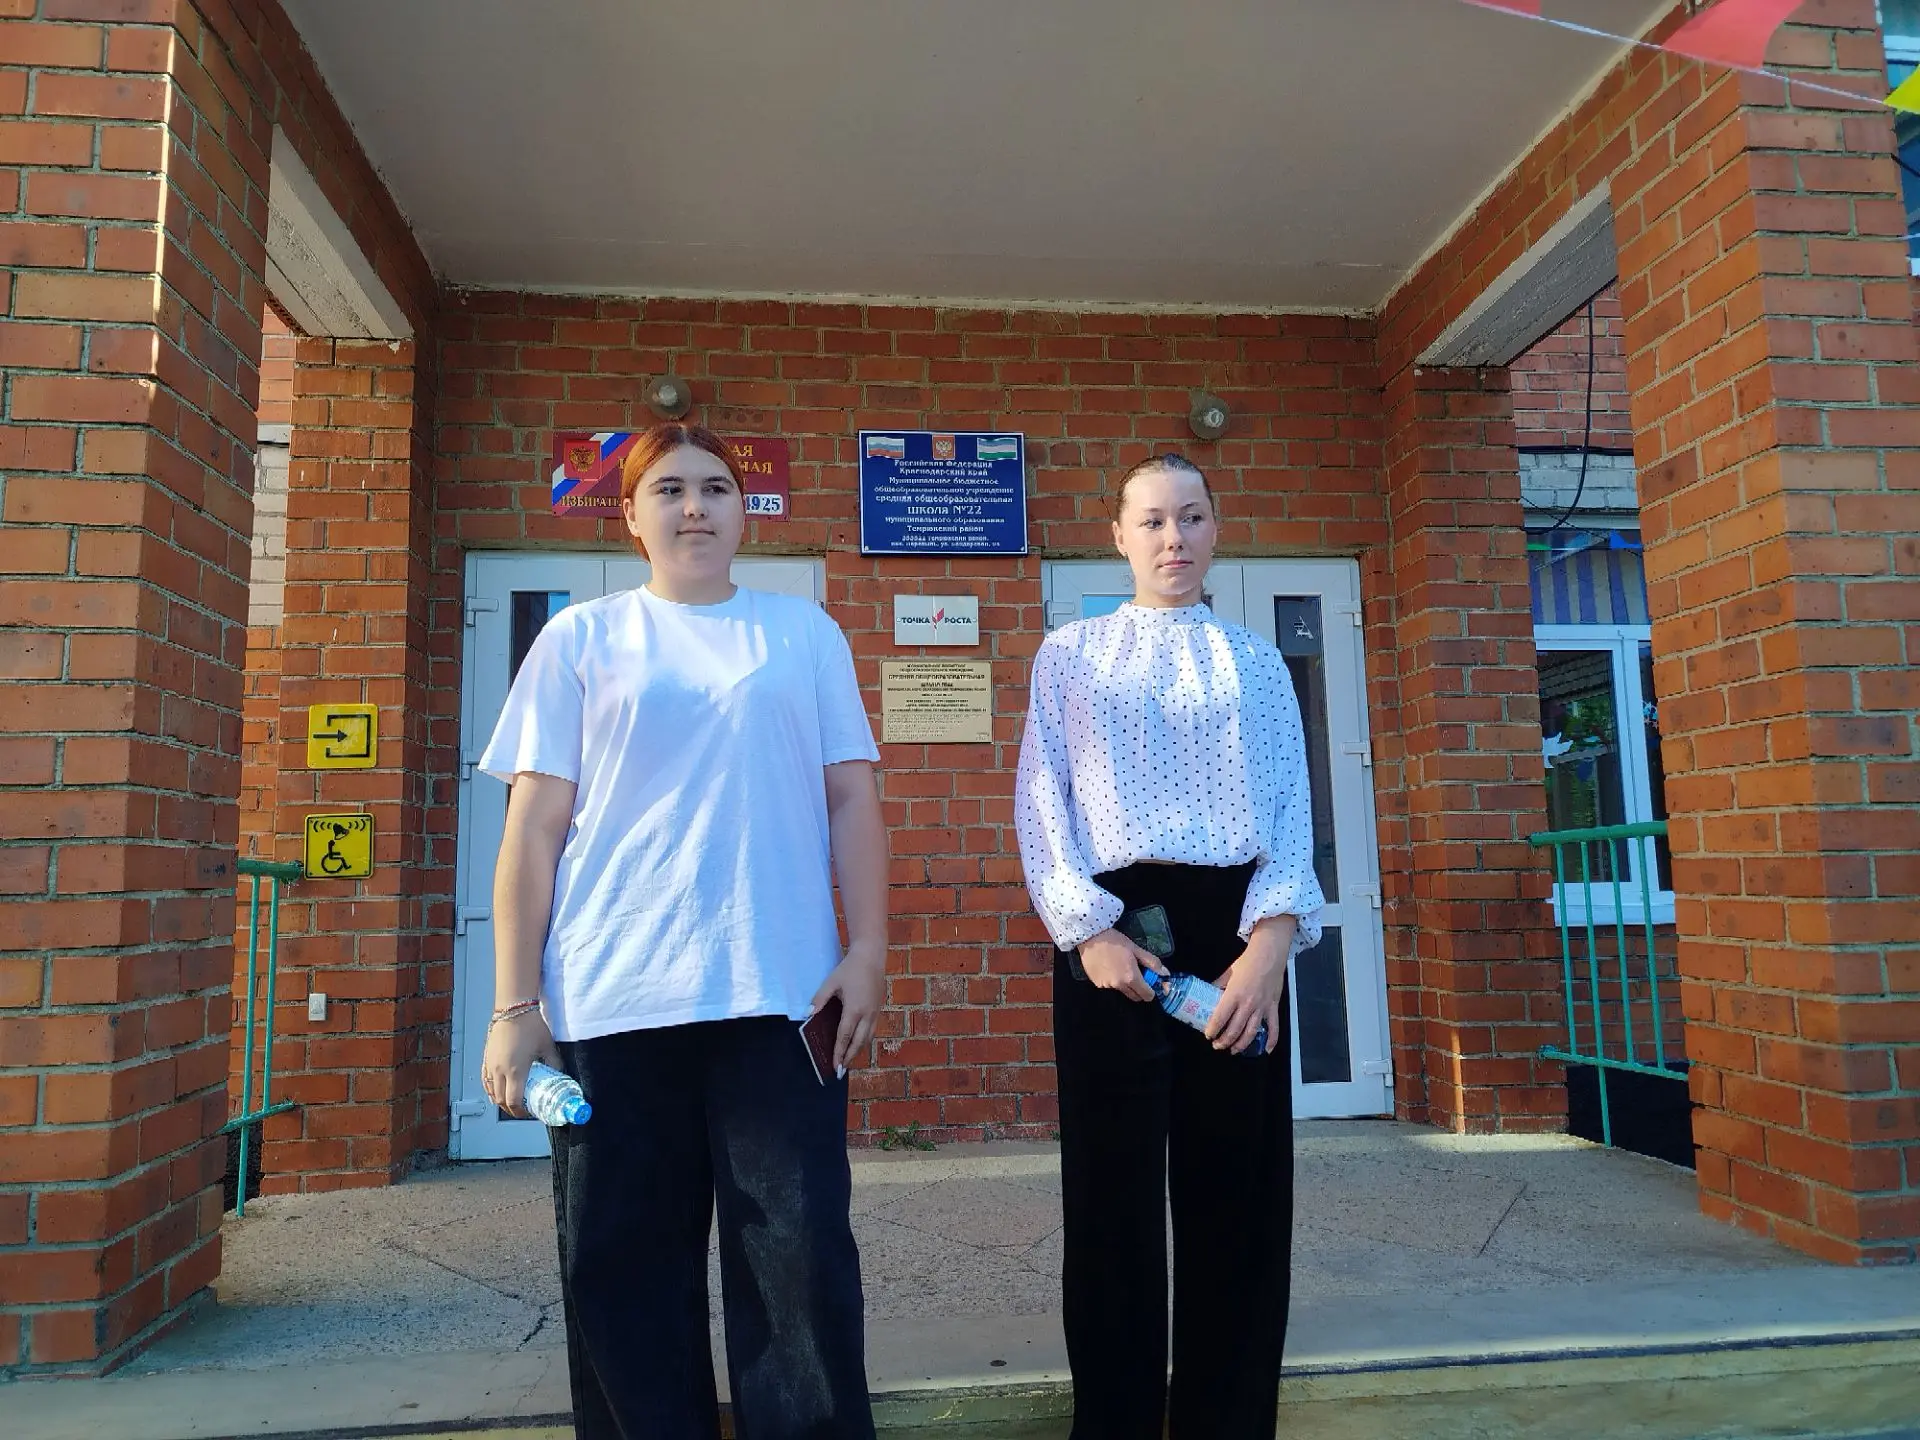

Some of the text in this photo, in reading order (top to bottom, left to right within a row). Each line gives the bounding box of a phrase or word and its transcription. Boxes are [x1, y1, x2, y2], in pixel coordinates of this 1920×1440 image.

[894, 459, 993, 468] Российская Федерация
[899, 467, 966, 476] Краснодарский
[953, 477, 1000, 485] бюджетное
[561, 496, 623, 507] ИЗБИРАТЕ
[875, 494, 1013, 504] средняя общеобразовательная
